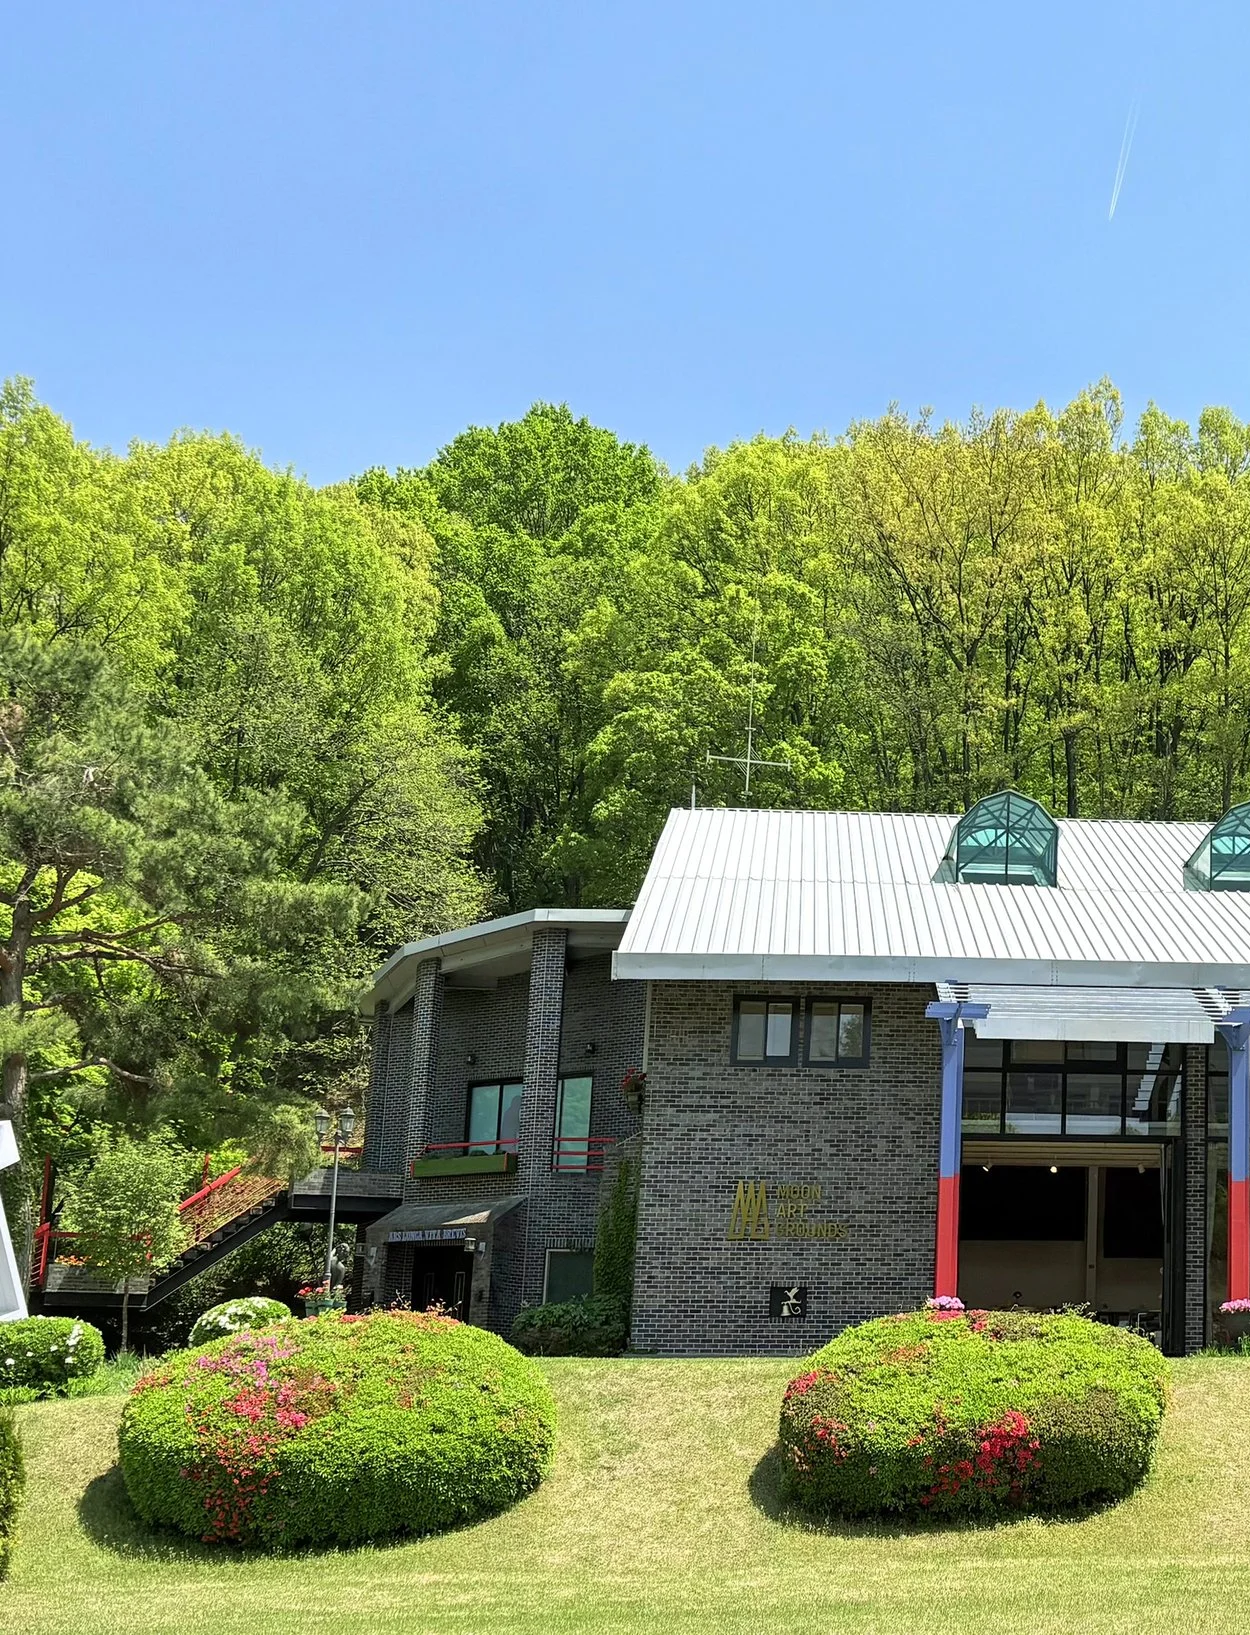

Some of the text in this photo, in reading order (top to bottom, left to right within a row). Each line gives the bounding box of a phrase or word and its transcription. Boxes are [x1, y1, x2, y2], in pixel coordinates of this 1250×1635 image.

[777, 1184, 821, 1200] MOON
[776, 1203, 808, 1218] ART
[775, 1222, 849, 1238] GROUNDS
